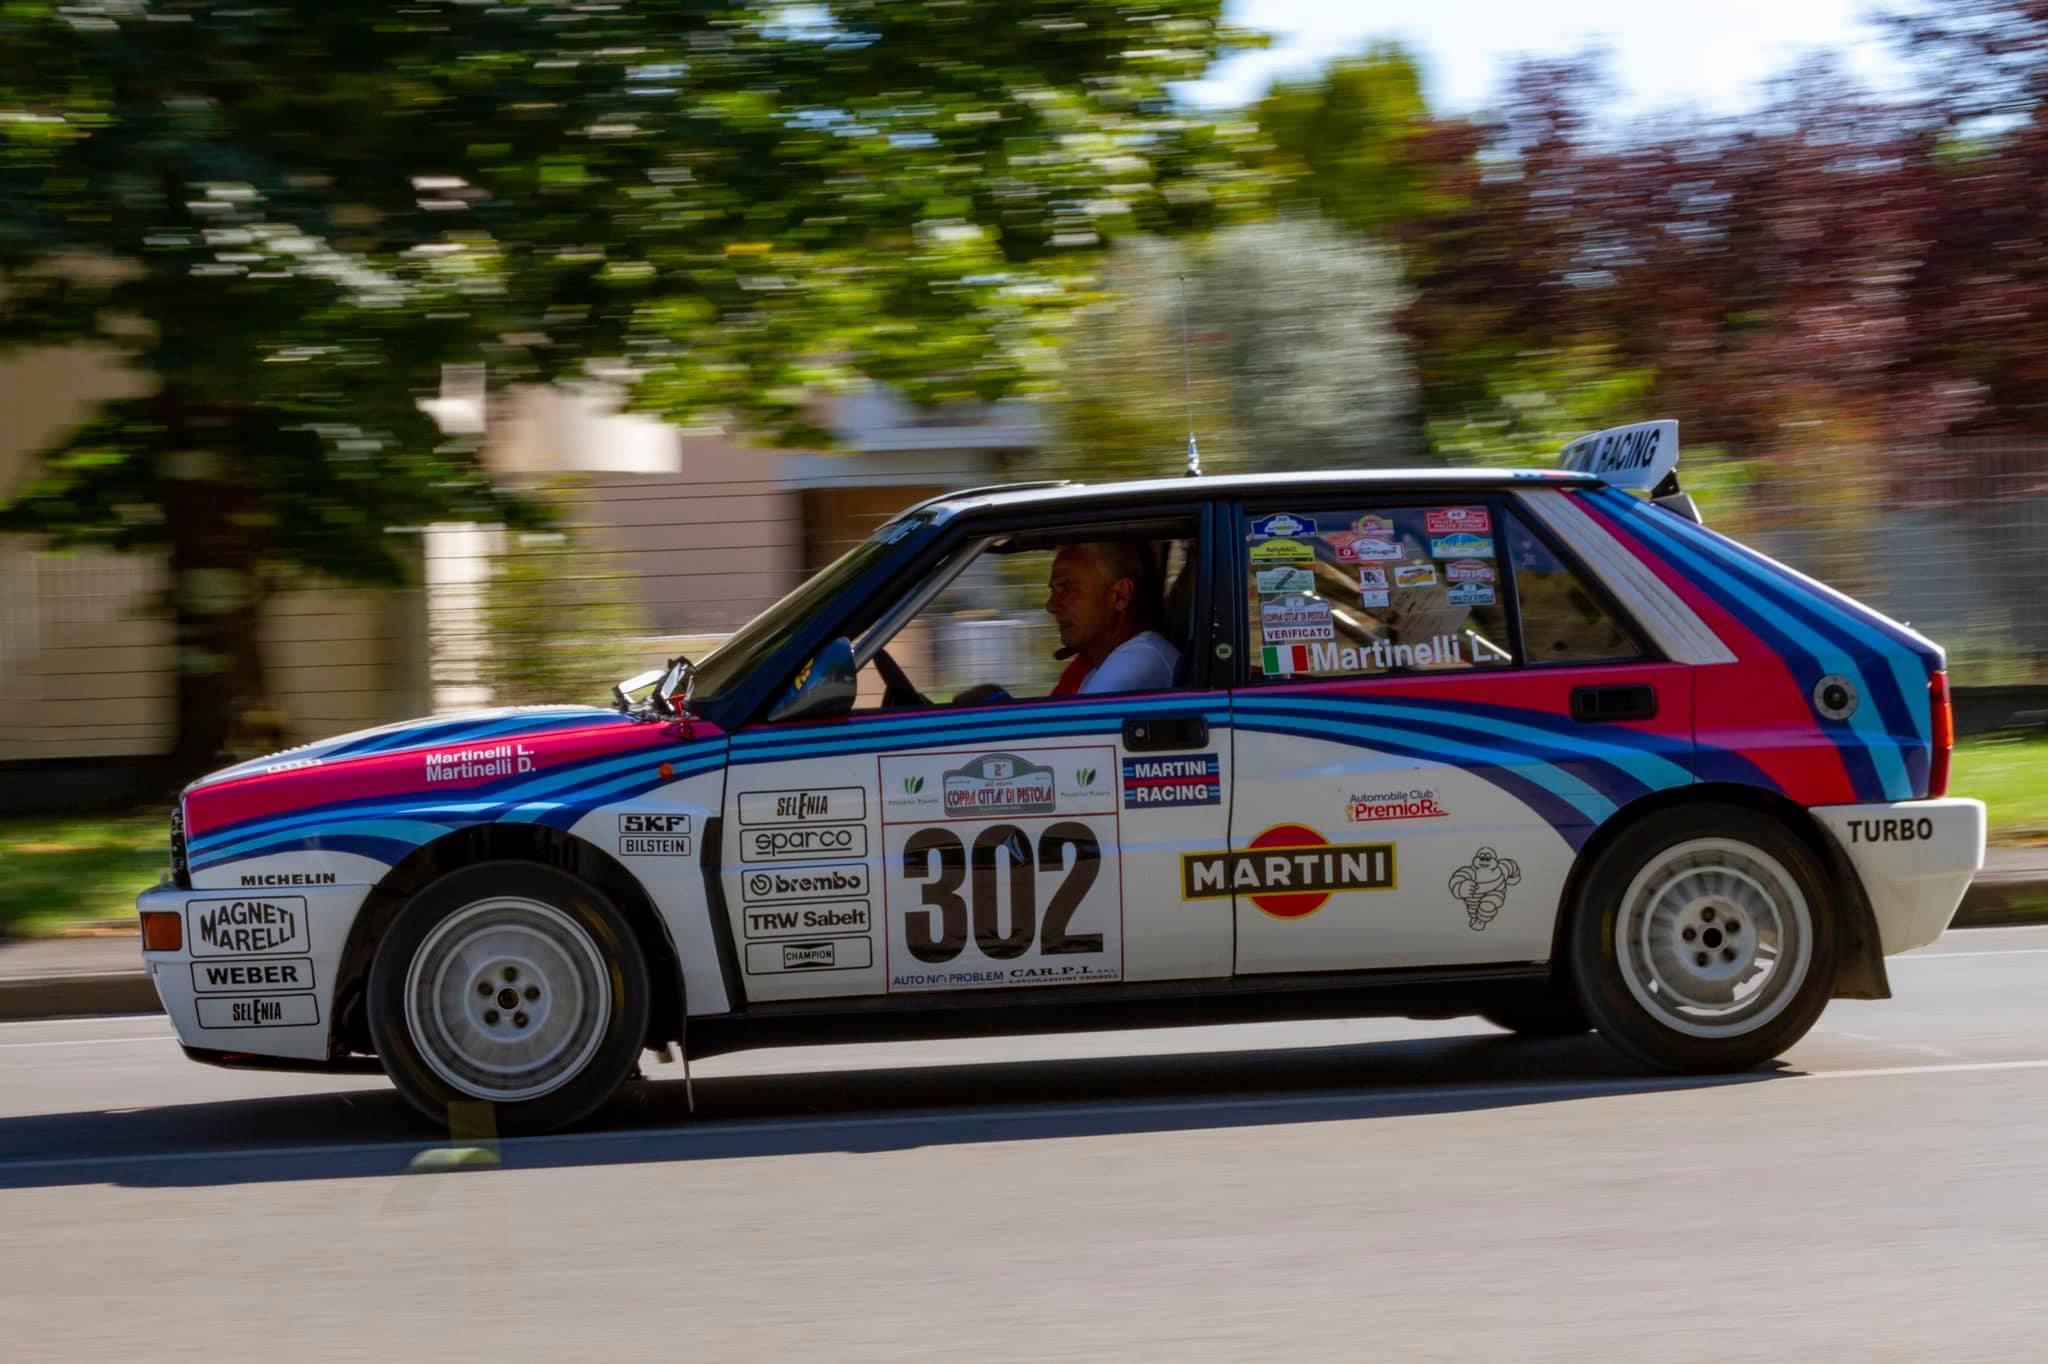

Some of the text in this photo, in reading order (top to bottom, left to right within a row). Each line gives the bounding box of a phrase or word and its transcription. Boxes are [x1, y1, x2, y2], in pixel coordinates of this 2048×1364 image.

[1600, 429, 1661, 470] RACING
[1267, 627, 1331, 639] VERIFICATO
[1312, 635, 1460, 672] Martinelli
[426, 743, 535, 766] Martinelli L.
[426, 756, 537, 782] Martinelli D.
[1135, 760, 1207, 778] MARTINI
[948, 788, 976, 806] COPPA
[1006, 787, 1014, 803] DI
[1137, 784, 1208, 803] RACING
[1350, 789, 1434, 803] Automobile Club
[777, 793, 828, 819] SELENIA
[625, 816, 685, 831] SKF
[1847, 817, 1933, 842] TURBO
[626, 840, 684, 853] BILSTEIN
[756, 830, 852, 856] sparco
[240, 873, 336, 886] MICHELIN
[1193, 852, 1385, 892] MARTINI
[776, 872, 861, 893] brembo
[903, 821, 1104, 964] 302
[200, 902, 296, 941] MAGNETI
[749, 910, 866, 930] TRW Sabelt
[200, 915, 296, 952] MARELLI
[786, 950, 832, 961] CHAMPION
[207, 966, 298, 985] WEBER
[894, 975, 924, 985] AUTO
[949, 971, 1004, 983] PROBLEM
[1010, 966, 1093, 978] CAR.P.I.
[233, 999, 281, 1025] SELENIA
